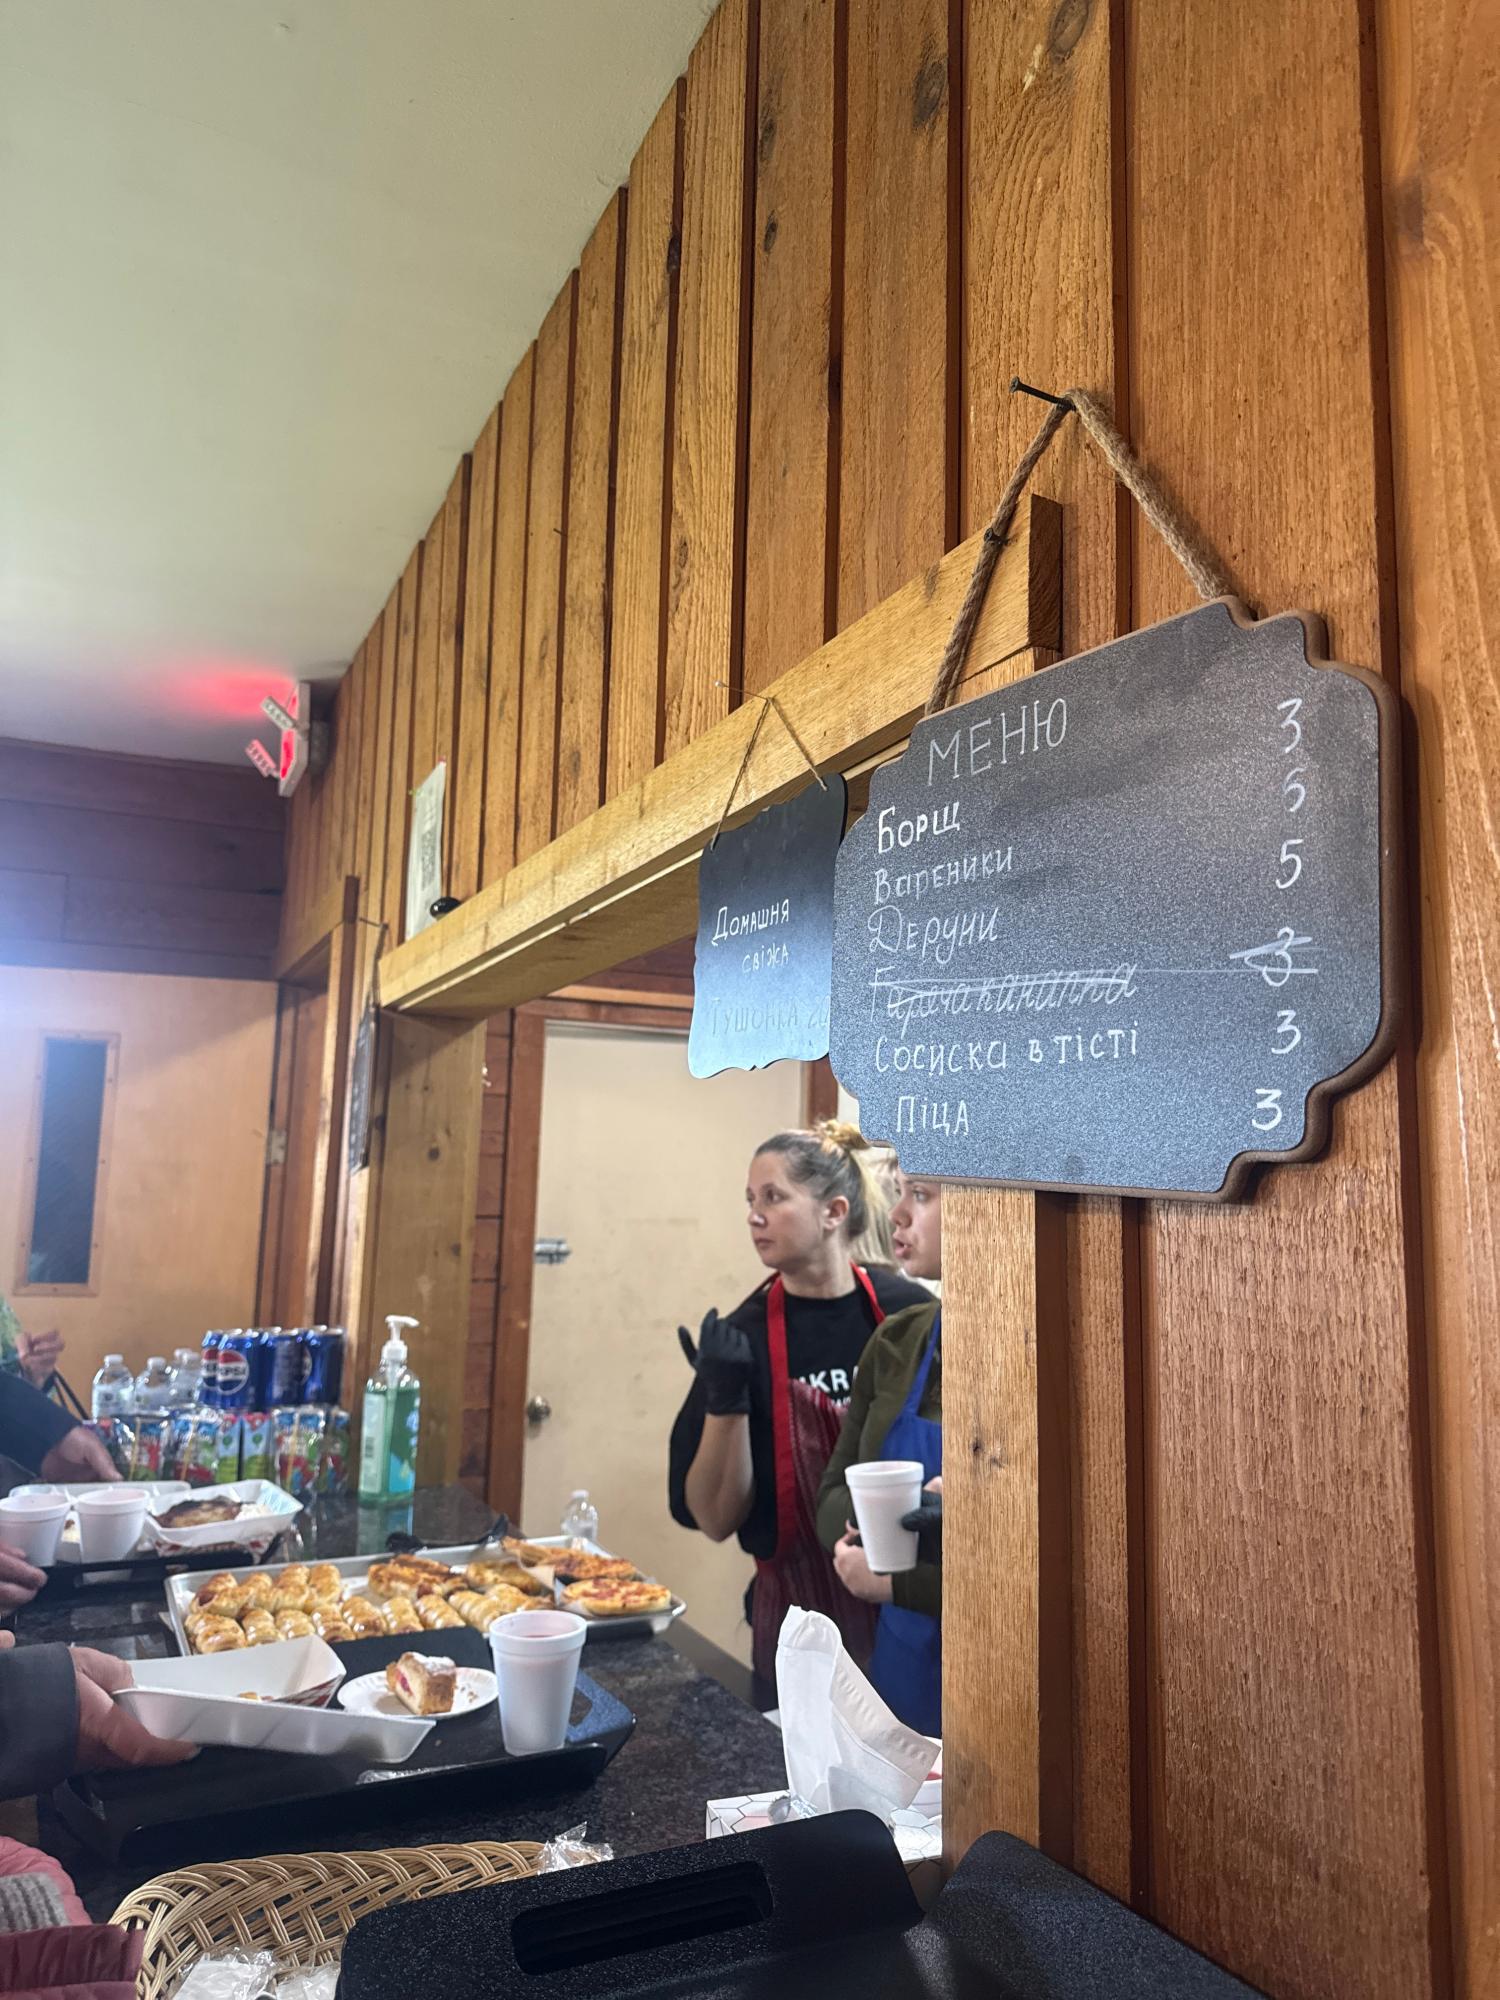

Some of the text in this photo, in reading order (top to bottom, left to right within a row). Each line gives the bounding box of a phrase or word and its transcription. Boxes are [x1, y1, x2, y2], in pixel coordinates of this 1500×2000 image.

[877, 698, 1302, 855] Борщ 3
[926, 698, 1067, 787] МЕНЮ
[873, 767, 1306, 905] Вареники 5
[867, 839, 1303, 965] Деруни 5
[875, 1035, 1007, 1077] Сосиска
[1271, 1010, 1301, 1054] 3
[1251, 1088, 1283, 1131] 3
